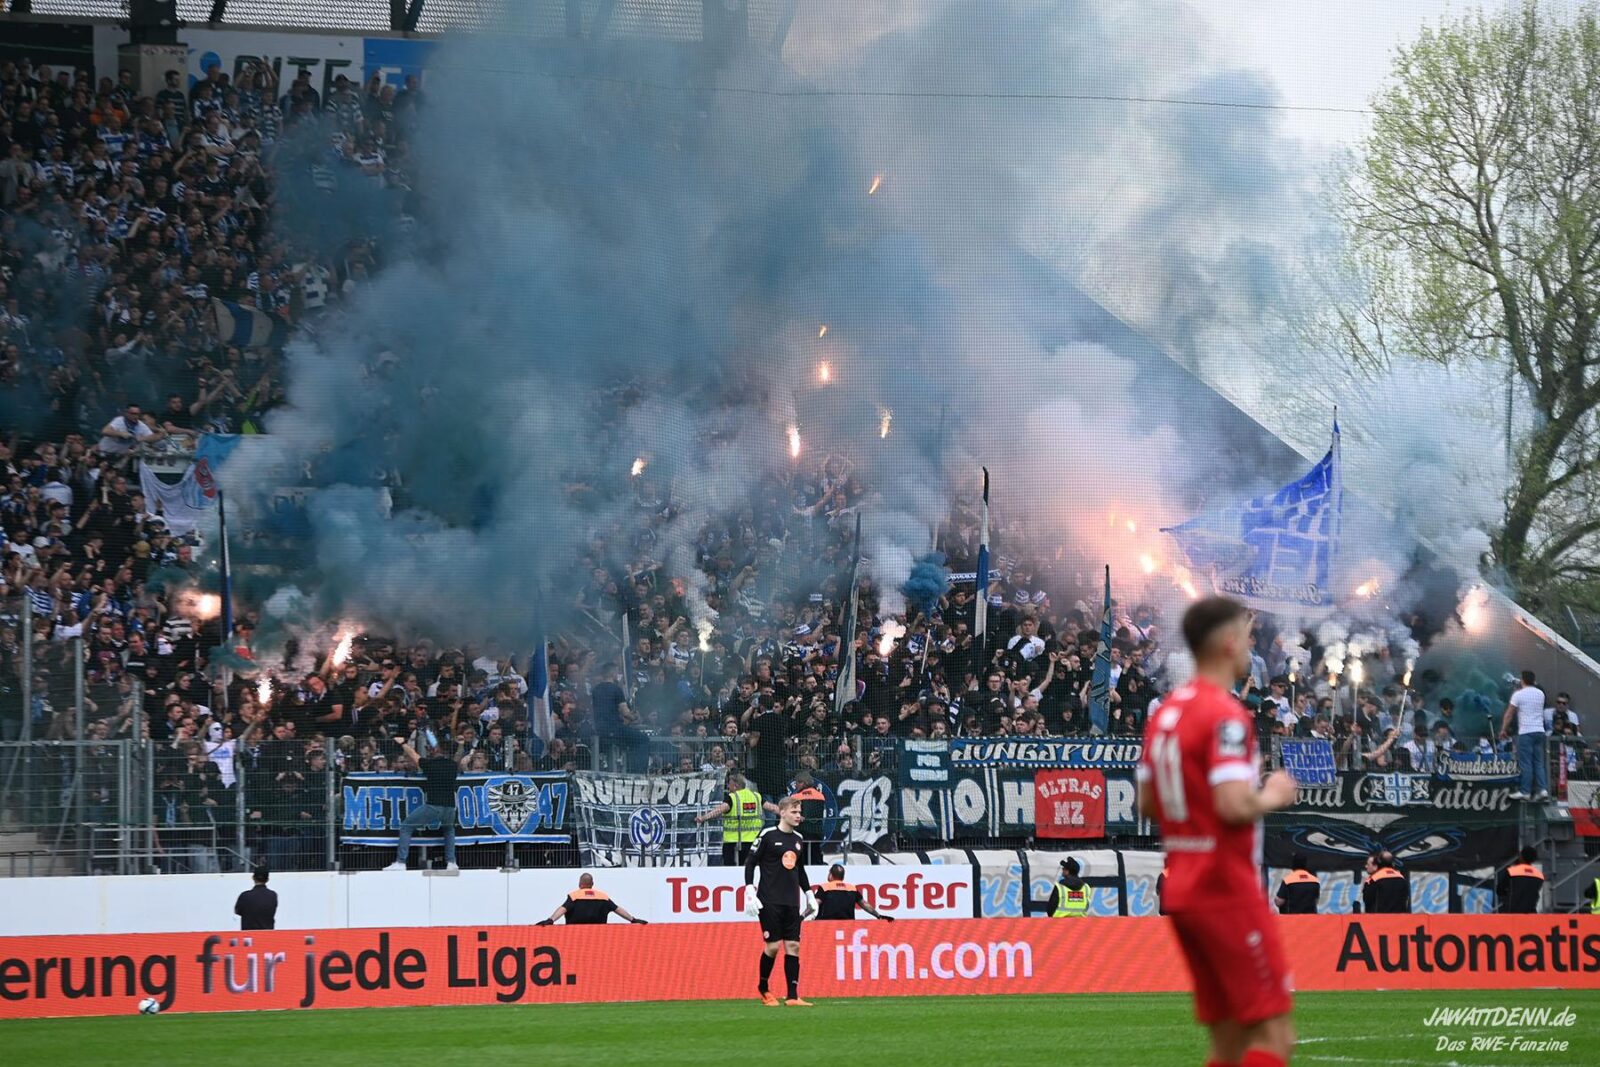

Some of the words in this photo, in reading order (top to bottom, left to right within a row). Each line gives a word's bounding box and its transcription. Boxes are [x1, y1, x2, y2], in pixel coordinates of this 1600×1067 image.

[1282, 740, 1331, 755] SEKTION
[1284, 754, 1335, 769] STADION
[506, 784, 521, 796] 47
[576, 777, 718, 806] RUHRPOTT
[1038, 778, 1103, 800] ULTRAS
[538, 782, 568, 830] 47
[666, 872, 968, 914] Terrnsfer
[835, 928, 1033, 981] ifm.com
[196, 935, 286, 994] für
[300, 931, 428, 1008] jede
[447, 931, 577, 1003] Liga.
